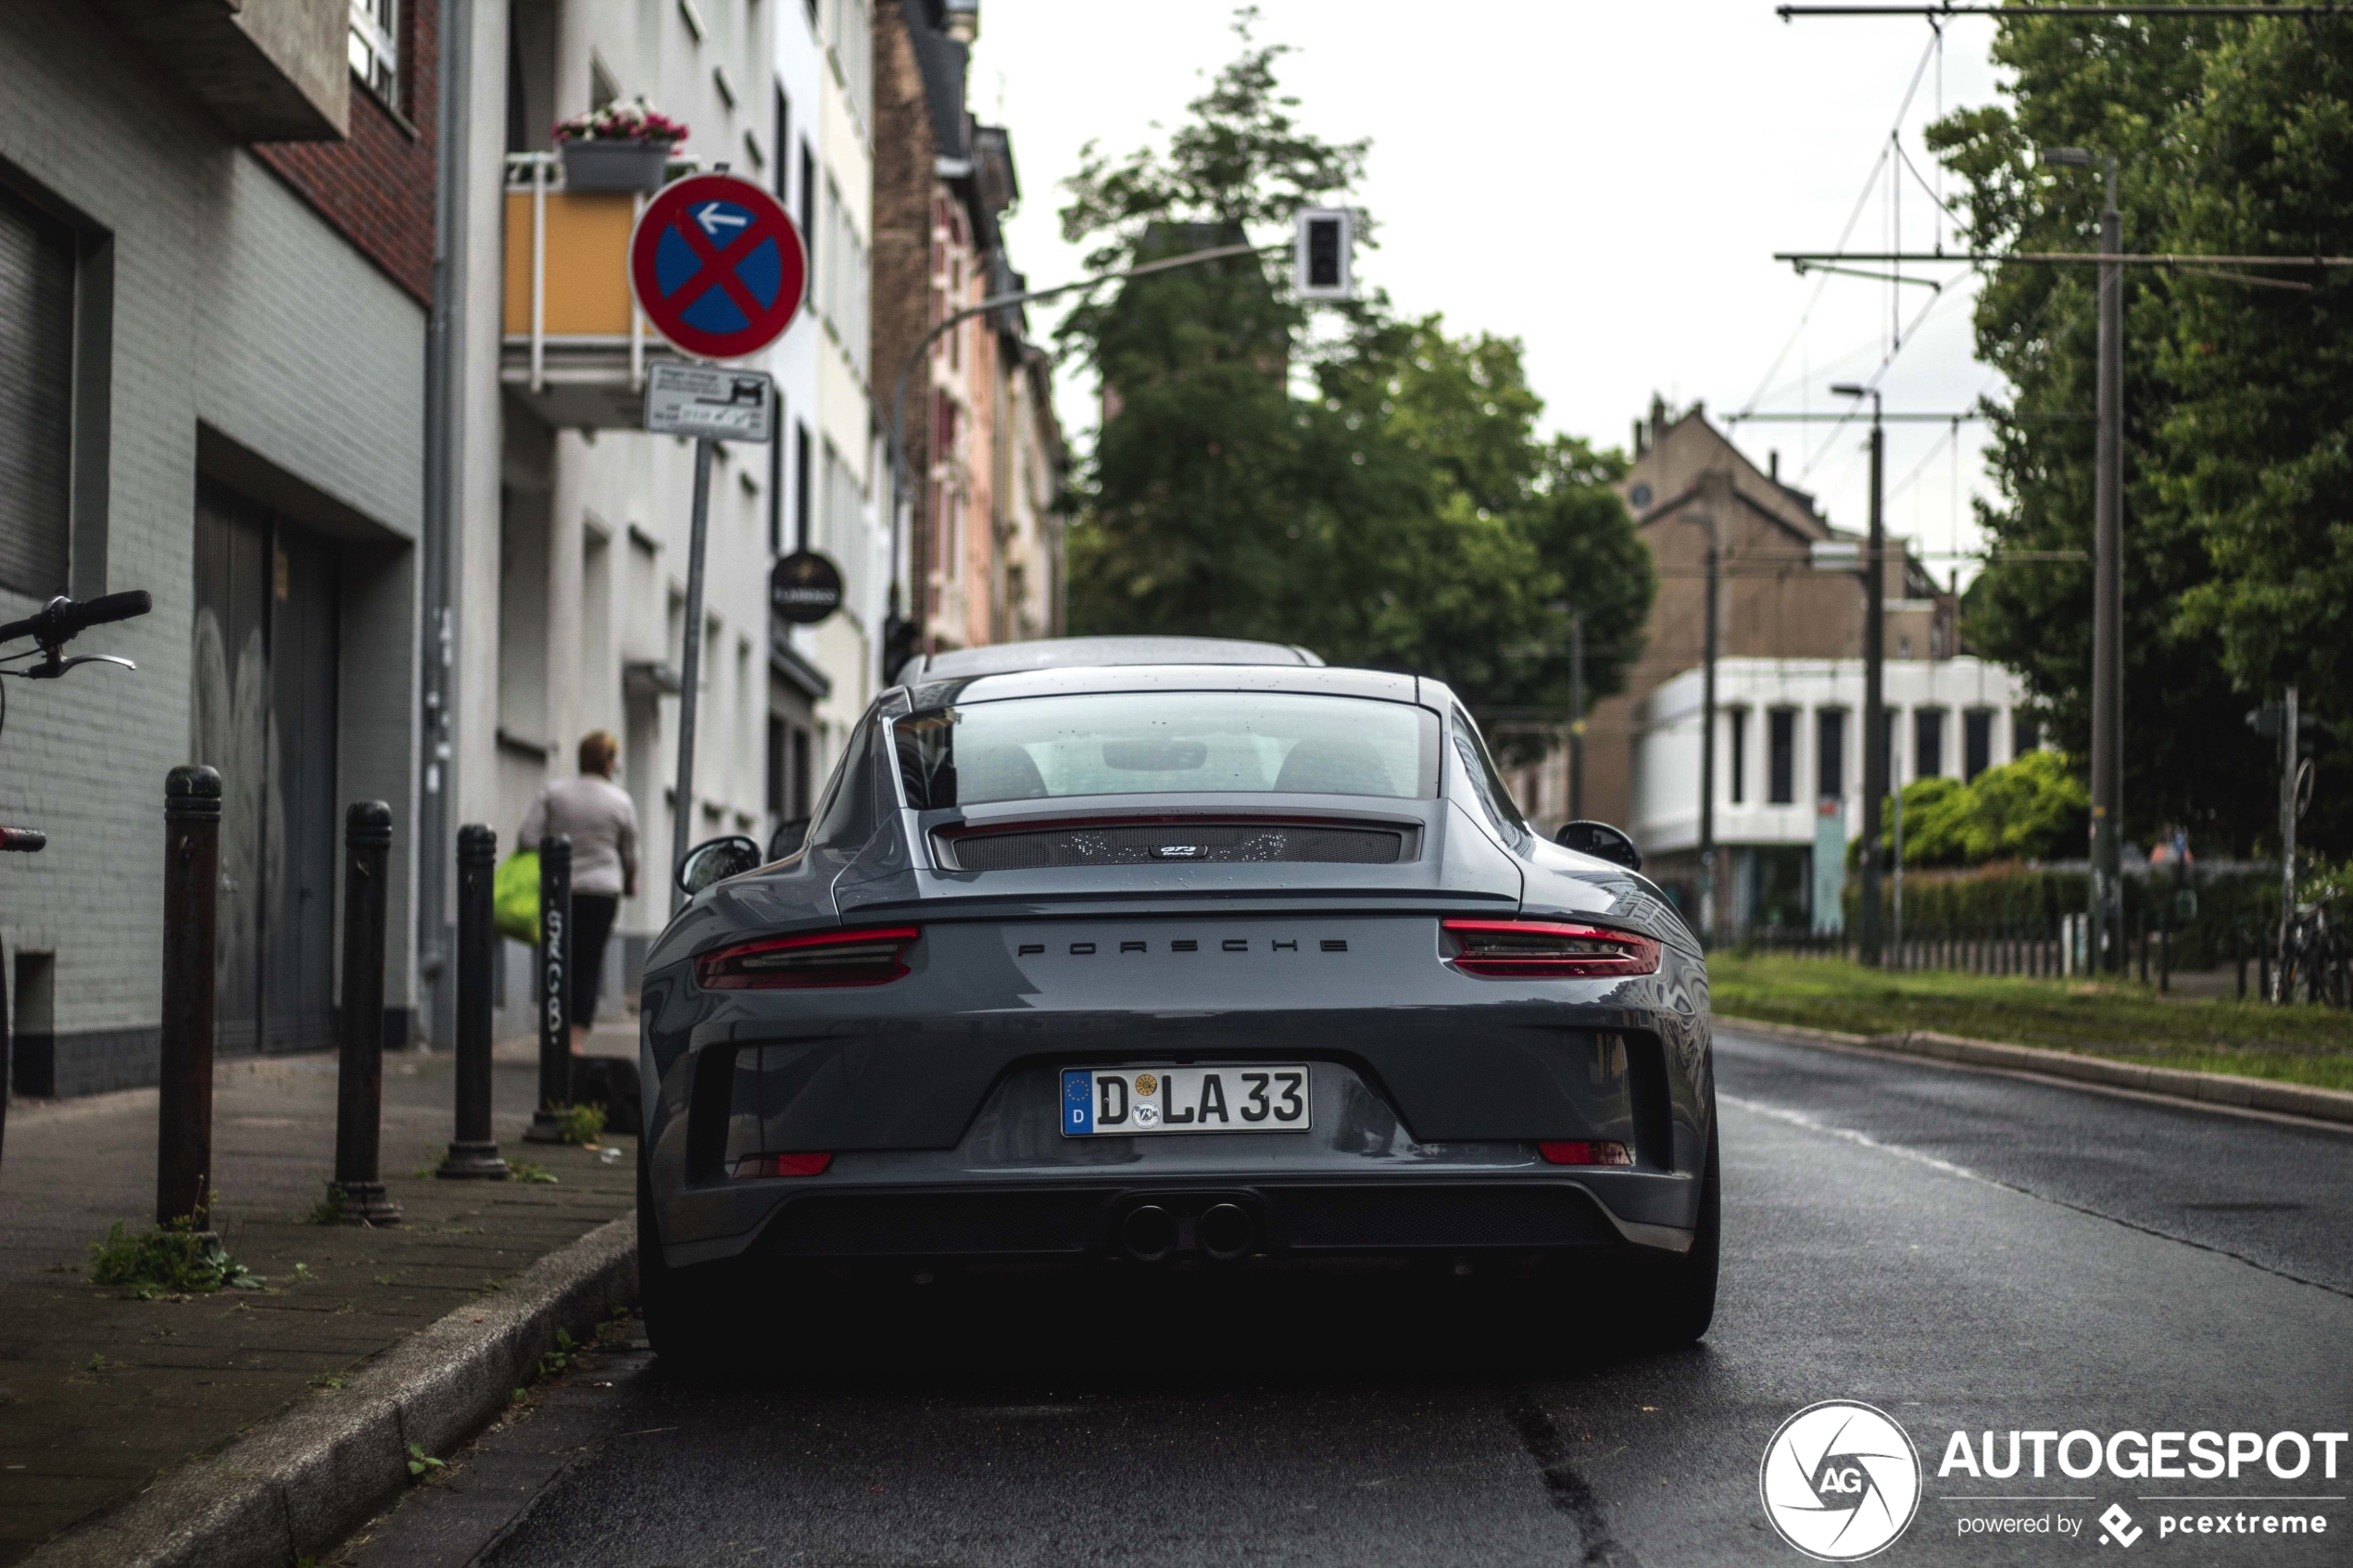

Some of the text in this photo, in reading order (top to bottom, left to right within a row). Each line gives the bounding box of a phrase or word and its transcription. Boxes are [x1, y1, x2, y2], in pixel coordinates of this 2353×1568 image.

[1018, 939, 1348, 957] PORSCHE
[1097, 1075, 1129, 1125] D
[1163, 1073, 1229, 1124] LA
[1240, 1072, 1303, 1123] 33
[1073, 1109, 1085, 1123] D
